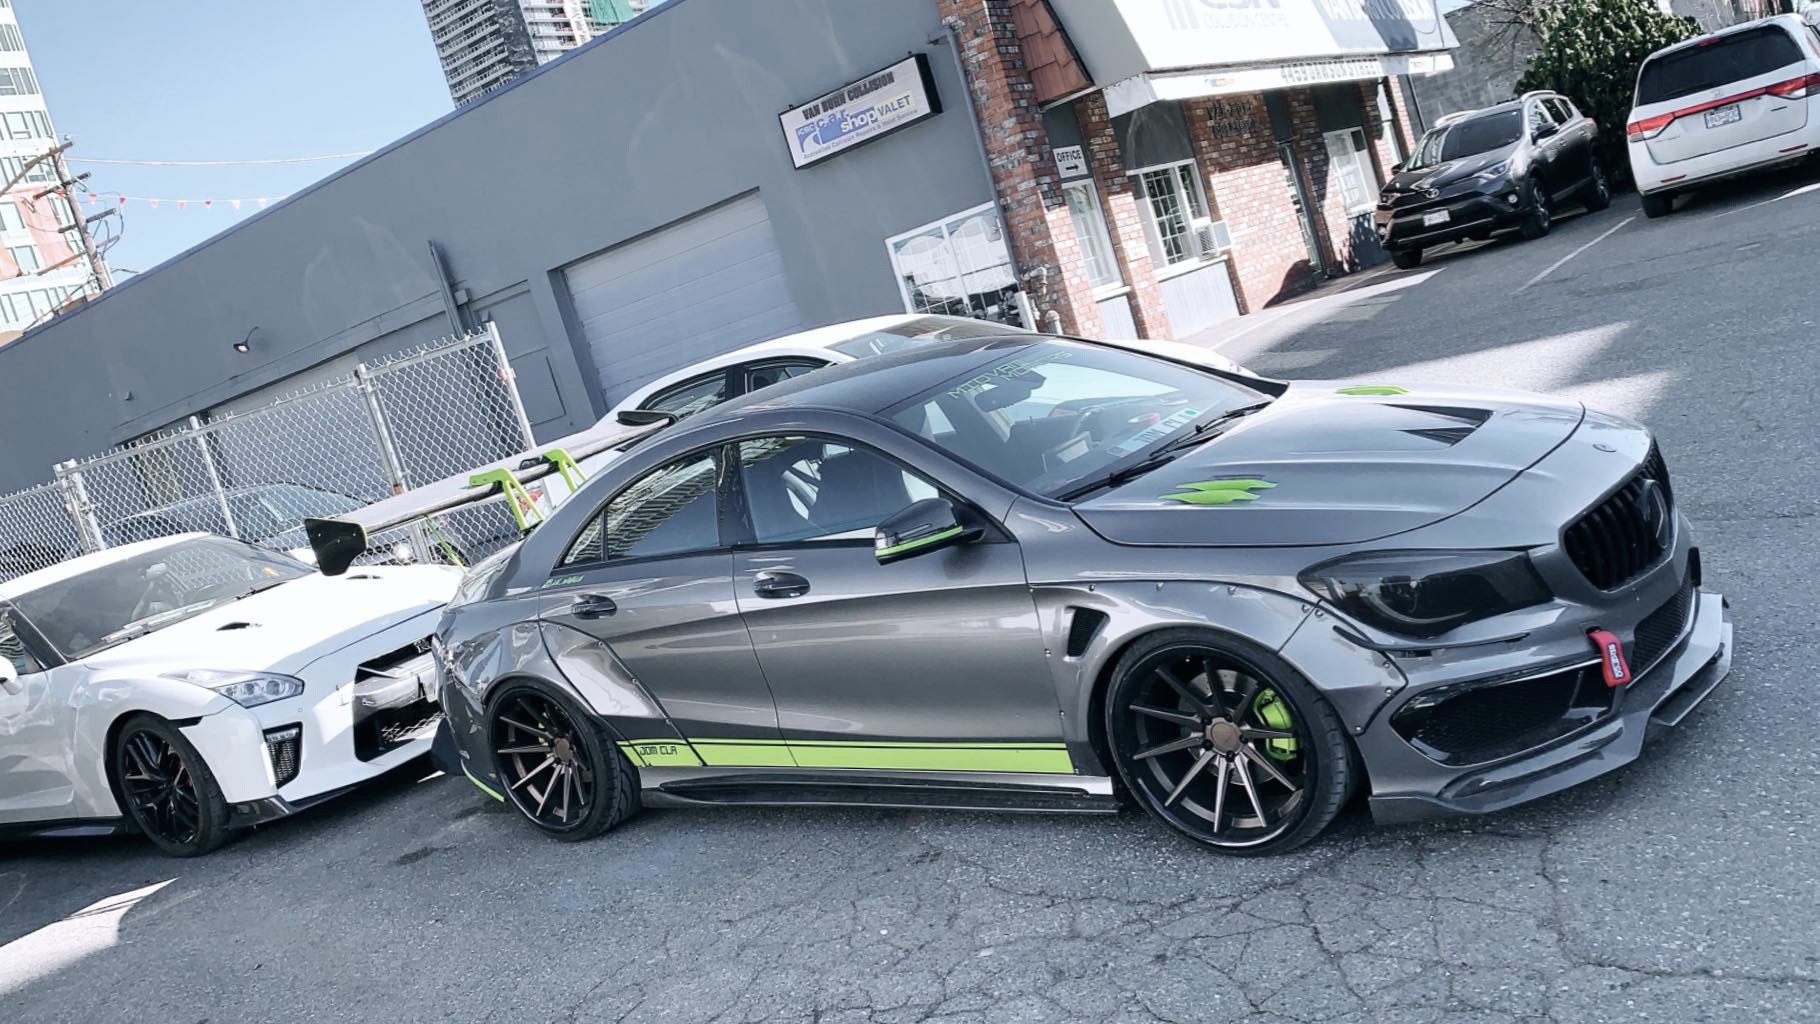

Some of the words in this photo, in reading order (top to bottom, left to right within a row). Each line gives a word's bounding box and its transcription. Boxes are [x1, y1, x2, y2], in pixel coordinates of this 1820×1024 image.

[802, 104, 821, 120] VAN
[847, 71, 895, 102] COLLISION
[840, 110, 877, 133] shop
[877, 95, 911, 117] VALET
[1056, 149, 1083, 163] OFFICE
